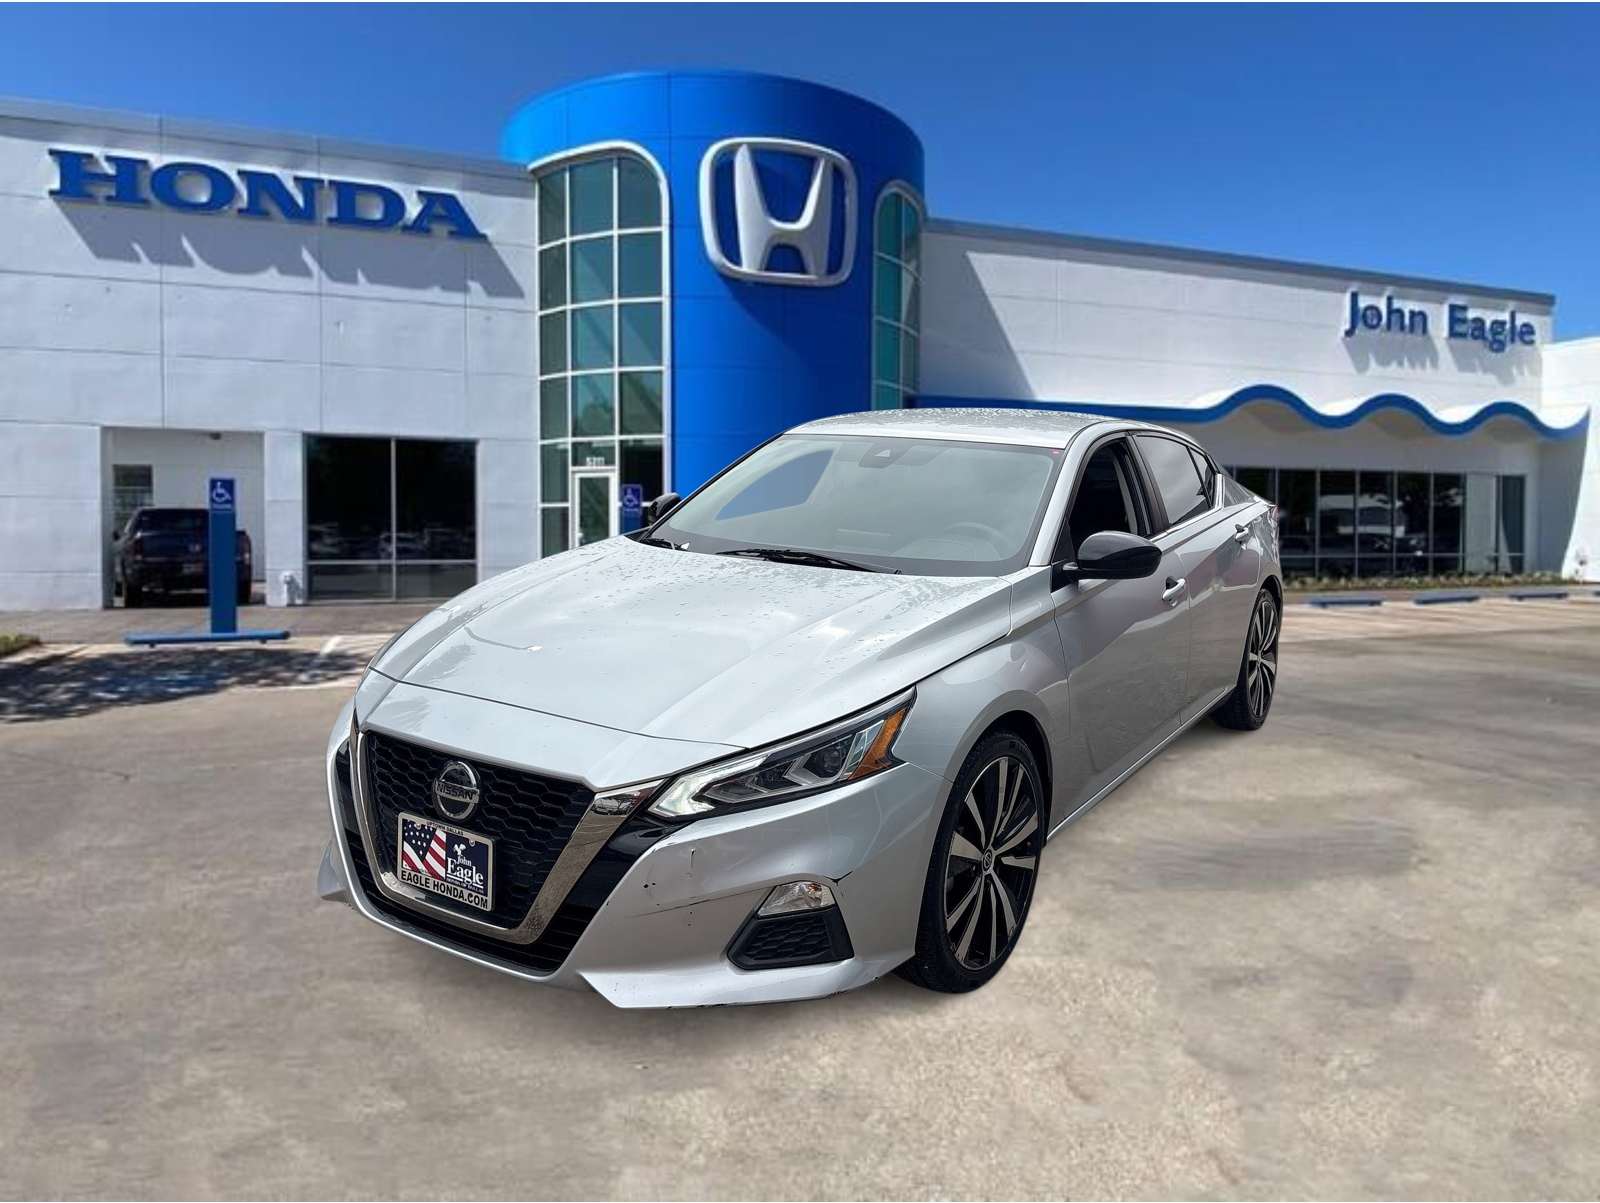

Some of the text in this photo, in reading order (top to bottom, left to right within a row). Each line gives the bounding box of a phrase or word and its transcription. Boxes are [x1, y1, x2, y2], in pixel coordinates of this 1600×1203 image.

[48, 148, 489, 241] HONDA
[1344, 290, 1536, 353] John Eagle
[437, 785, 474, 800] NISSAN
[447, 857, 484, 885] Eagle
[456, 857, 472, 866] John
[401, 871, 430, 888] EAGLE
[433, 879, 488, 909] HONDA.COM
